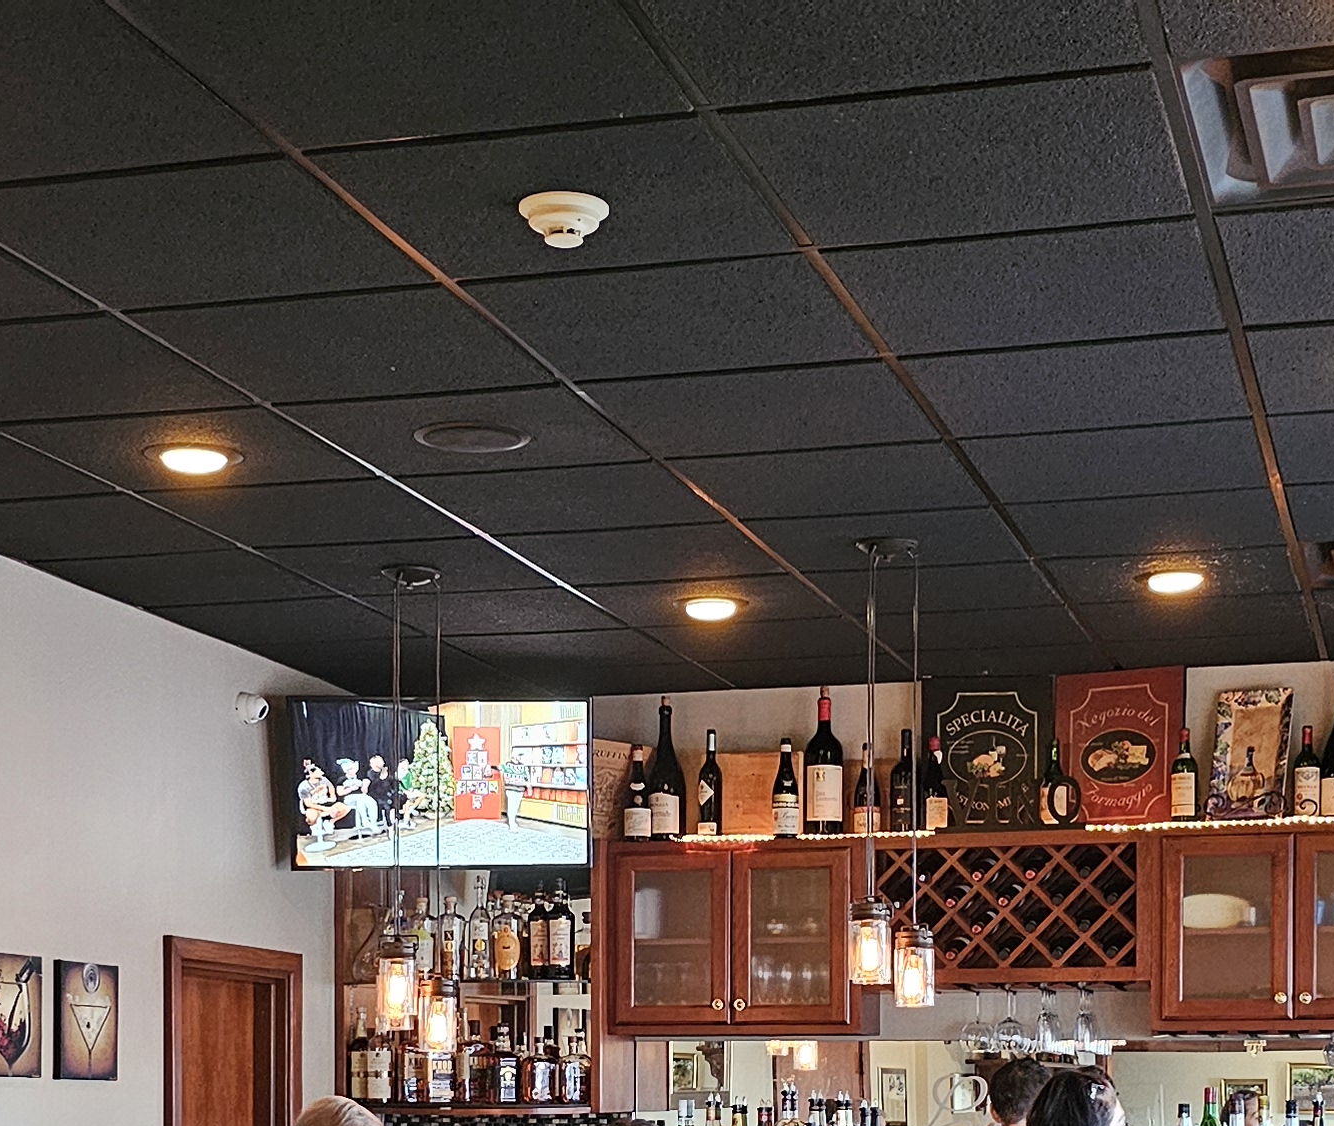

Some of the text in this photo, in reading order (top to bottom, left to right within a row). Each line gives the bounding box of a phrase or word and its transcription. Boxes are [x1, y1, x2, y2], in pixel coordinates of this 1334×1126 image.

[1077, 703, 1163, 735] Negozio del
[1083, 781, 1153, 811] Formaggio
